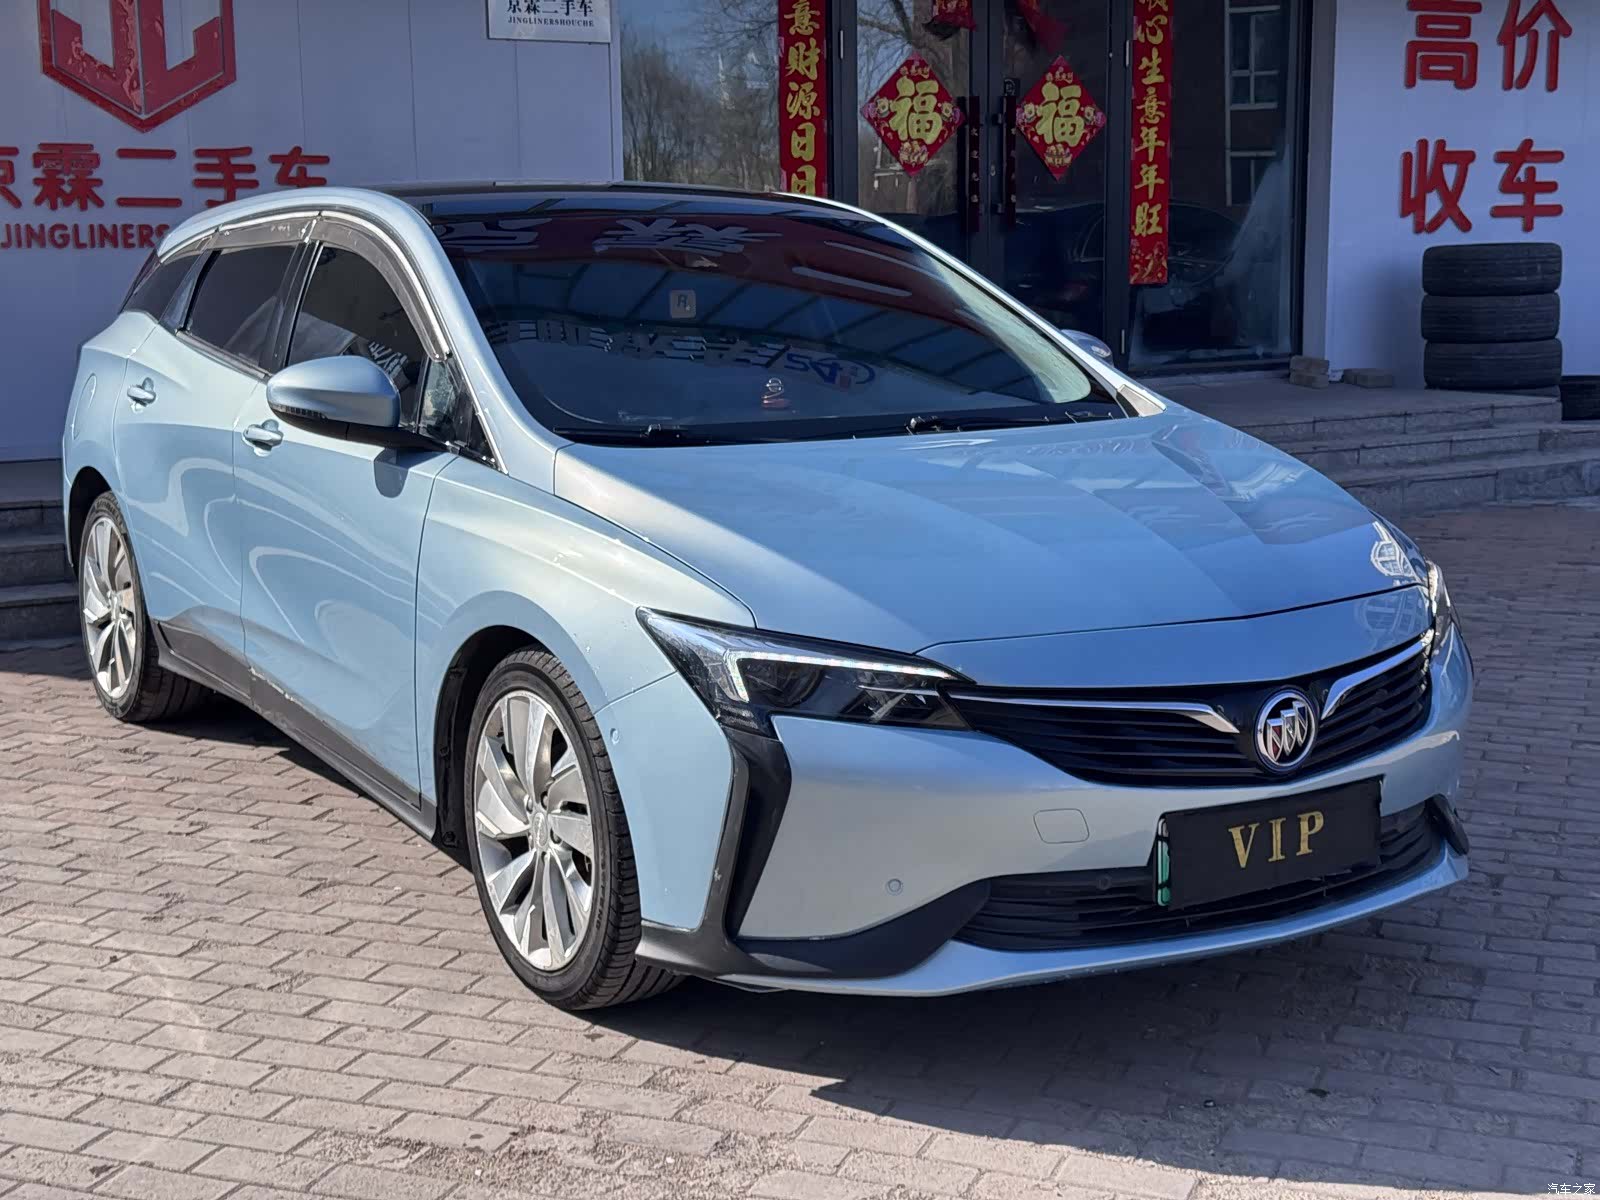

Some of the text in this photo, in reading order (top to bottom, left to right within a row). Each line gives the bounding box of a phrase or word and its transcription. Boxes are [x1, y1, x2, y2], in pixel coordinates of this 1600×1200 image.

[1405, 0, 1572, 91] 高价
[889, 77, 943, 145] 福
[1036, 82, 1085, 147] 福
[1398, 138, 1565, 234] 收车
[1228, 810, 1325, 869] VIP
